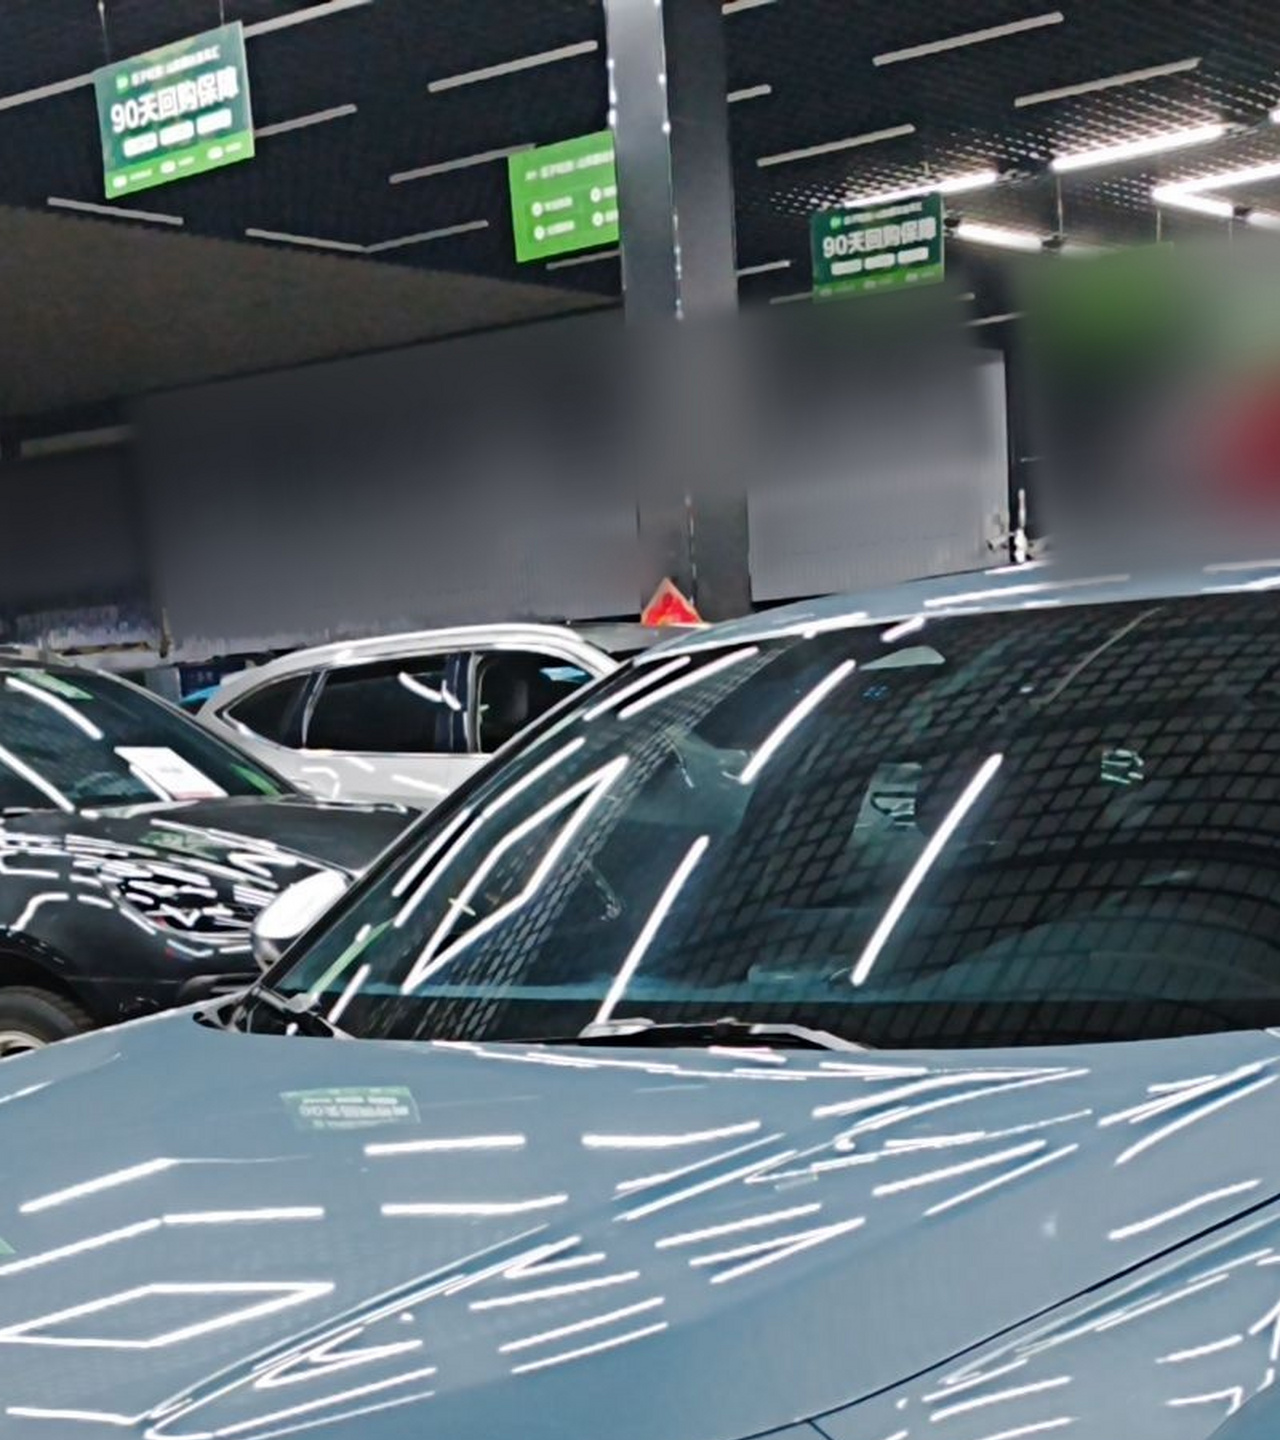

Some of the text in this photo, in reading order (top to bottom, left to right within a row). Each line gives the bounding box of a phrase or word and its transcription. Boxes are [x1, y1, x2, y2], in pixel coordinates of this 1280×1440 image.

[111, 67, 239, 132] 90天回购保障
[823, 217, 936, 258] 90天回购保障
